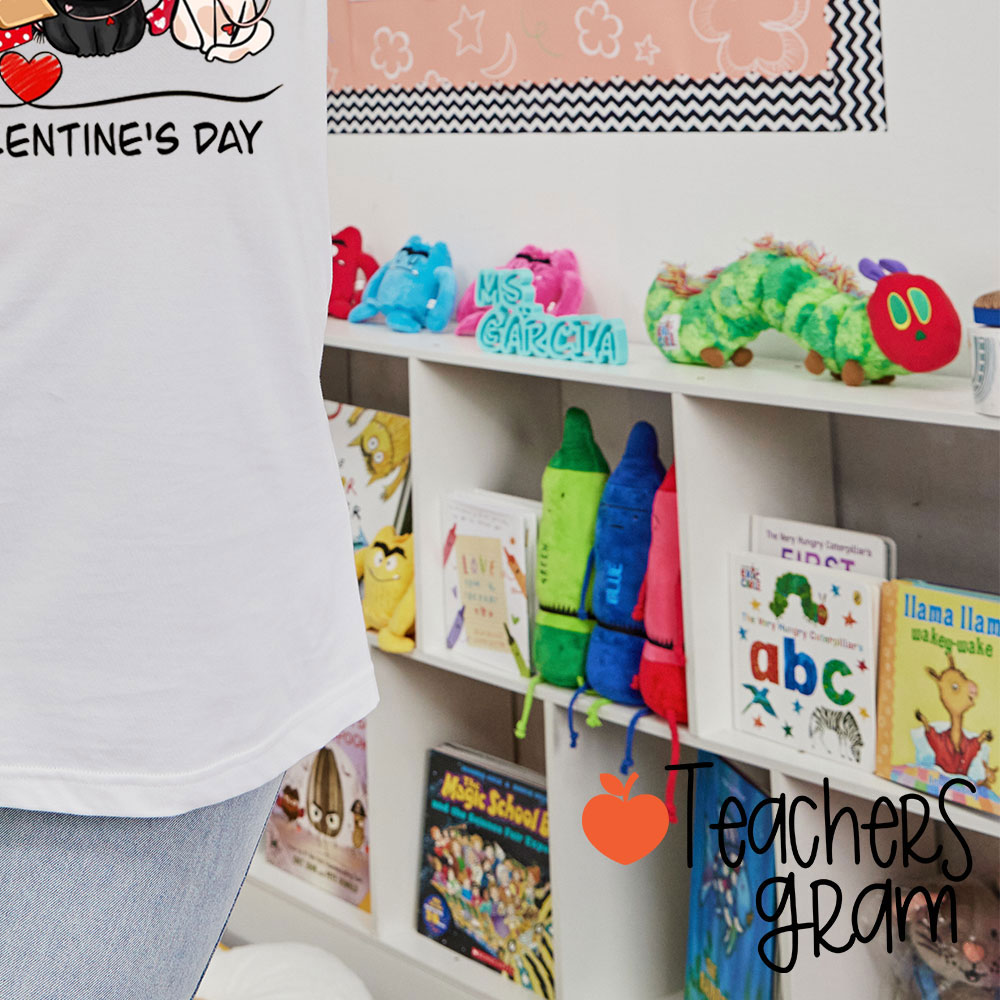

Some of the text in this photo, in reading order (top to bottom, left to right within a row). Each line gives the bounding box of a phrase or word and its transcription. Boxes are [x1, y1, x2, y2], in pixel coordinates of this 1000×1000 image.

[192, 119, 264, 157] DAY
[478, 310, 622, 365] GARCIA
[462, 554, 495, 576] LOVE
[904, 592, 1000, 638] llama llam
[750, 636, 855, 706] abc
[440, 769, 487, 811] Magic
[486, 788, 540, 833] School
